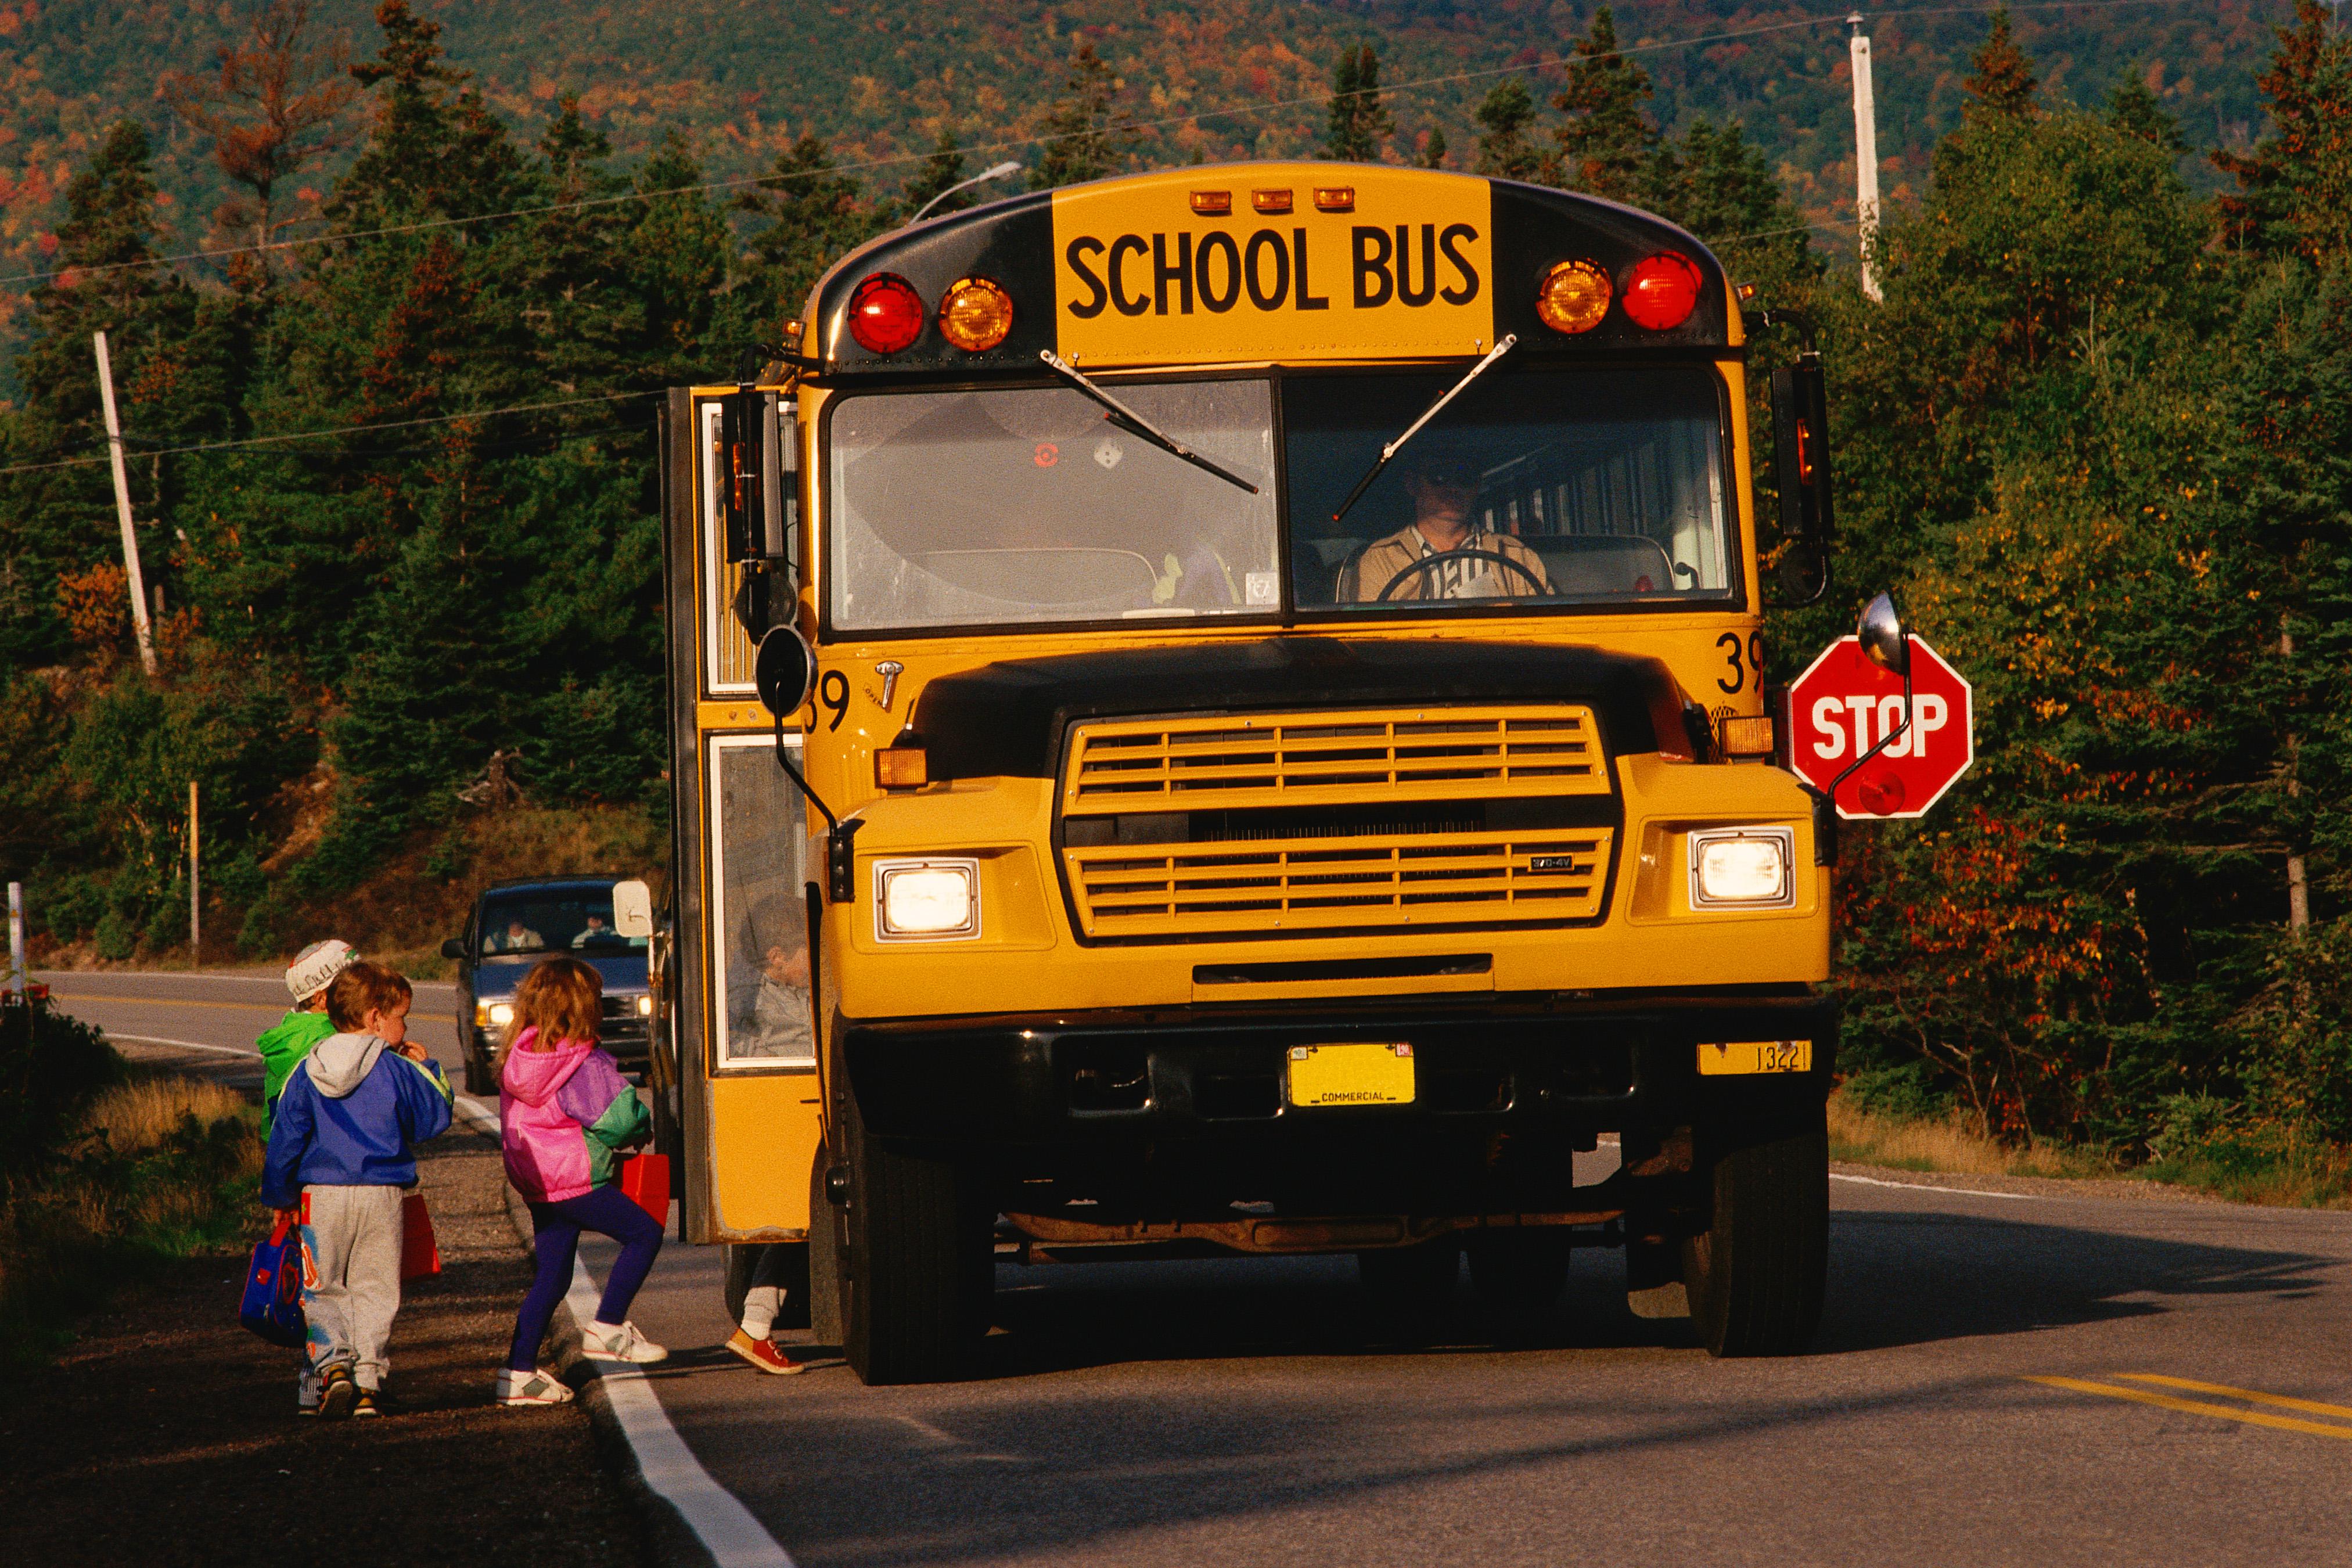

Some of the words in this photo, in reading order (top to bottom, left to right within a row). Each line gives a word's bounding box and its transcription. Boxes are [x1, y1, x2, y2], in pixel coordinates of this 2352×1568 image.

[1066, 228, 1329, 319] SCHOOL
[1351, 224, 1479, 308] BUS
[1811, 693, 1948, 760] STOP
[1321, 1091, 1384, 1102] COMMERCIAL
